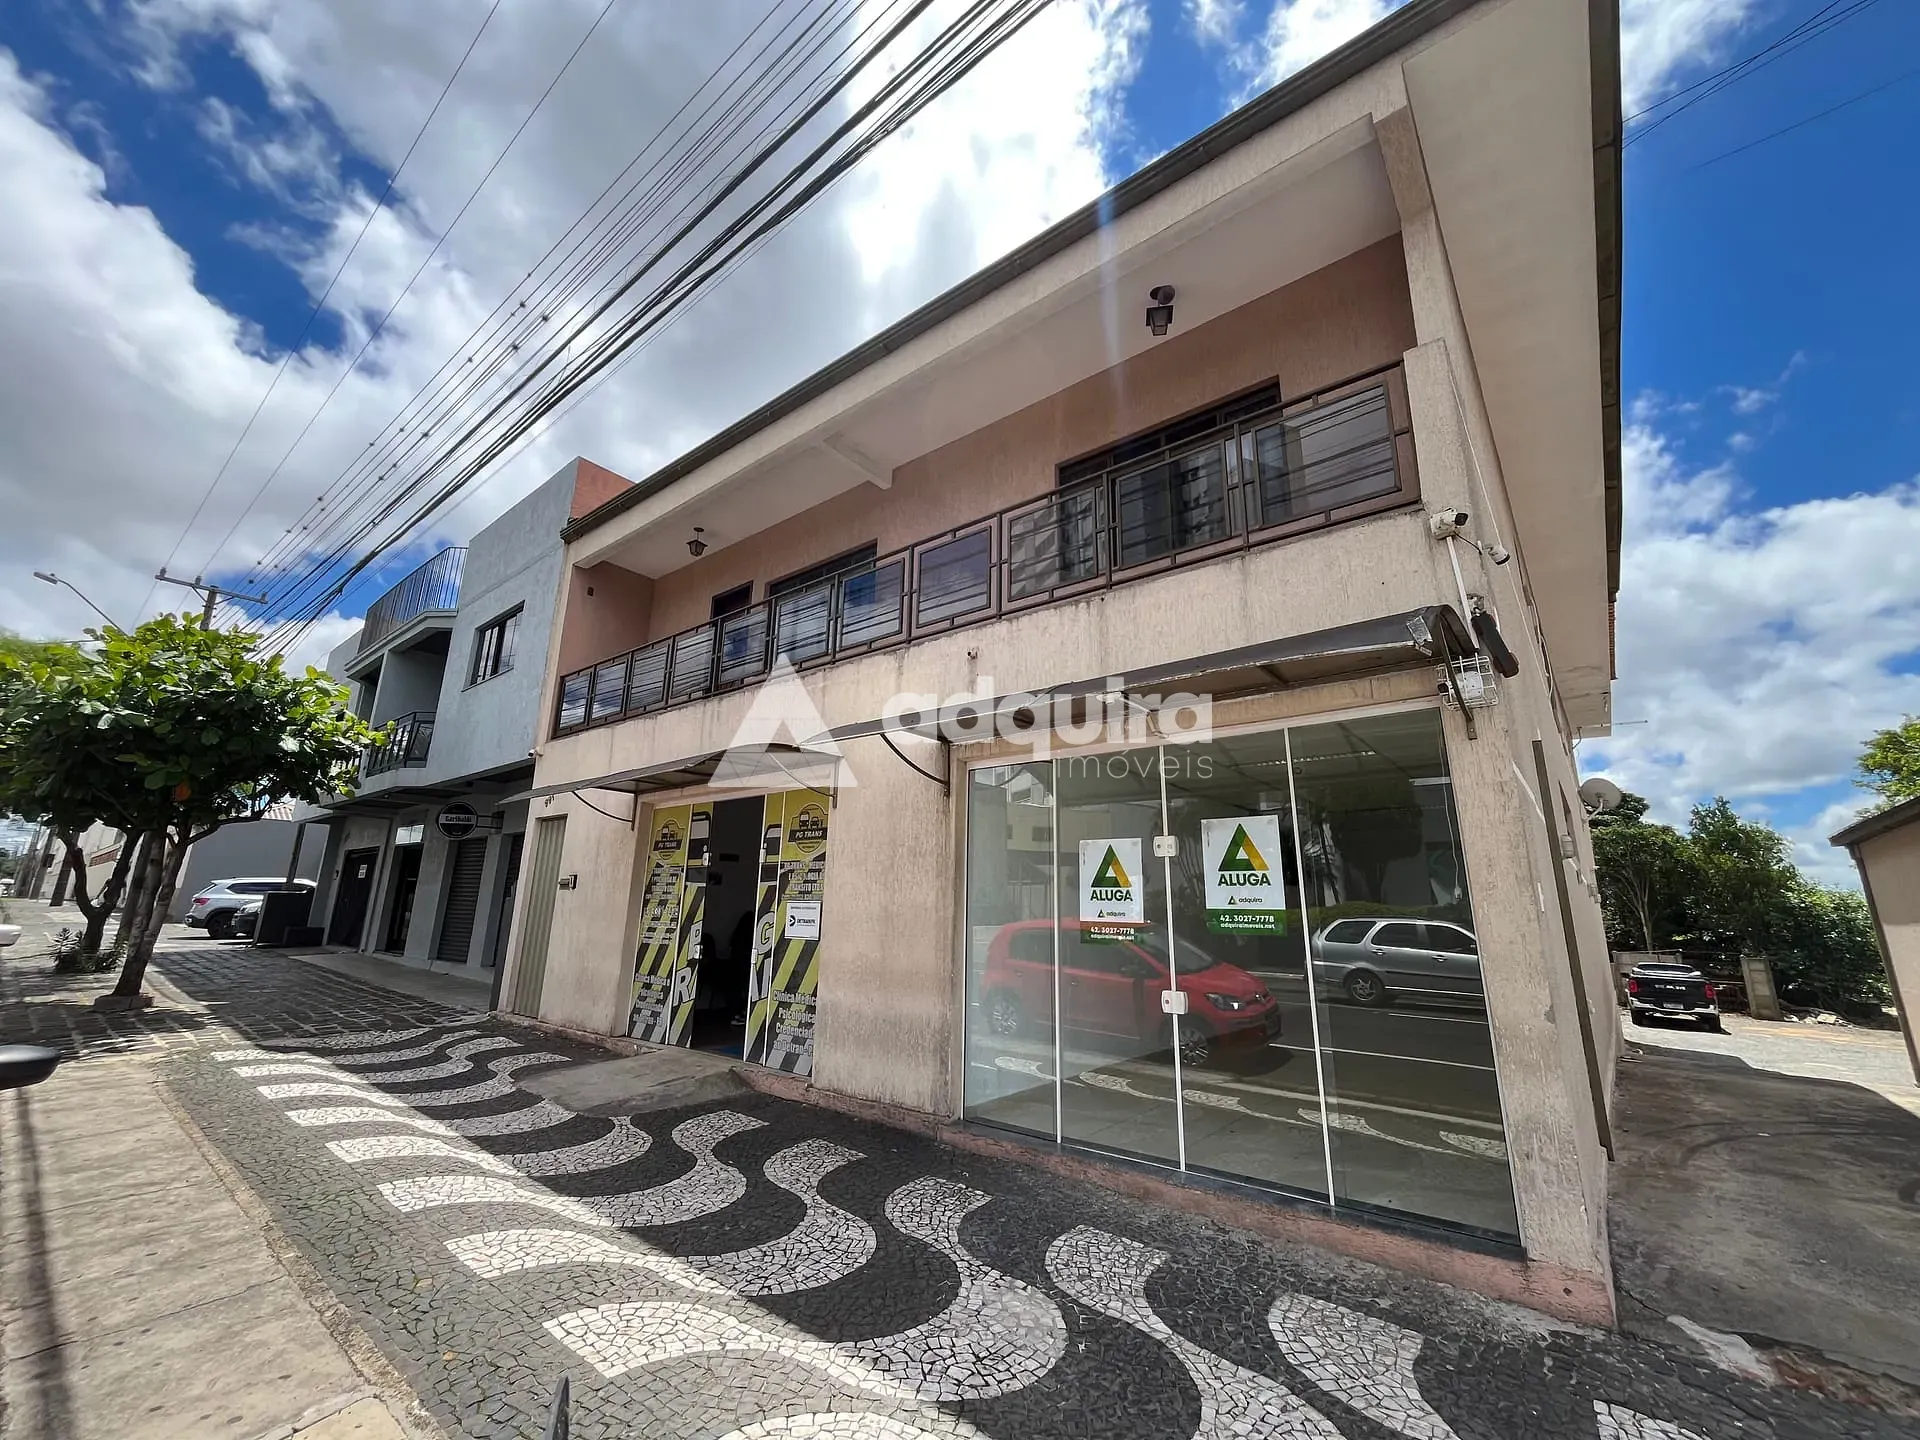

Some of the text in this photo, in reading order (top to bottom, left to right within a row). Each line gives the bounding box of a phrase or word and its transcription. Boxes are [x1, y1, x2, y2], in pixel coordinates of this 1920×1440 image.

[804, 830, 823, 838] TRANS
[1218, 873, 1271, 886] ALUGA
[1090, 889, 1133, 901] ALUGA
[1101, 926, 1135, 934] 3027-7778
[776, 1022, 814, 1038] Credenciad
